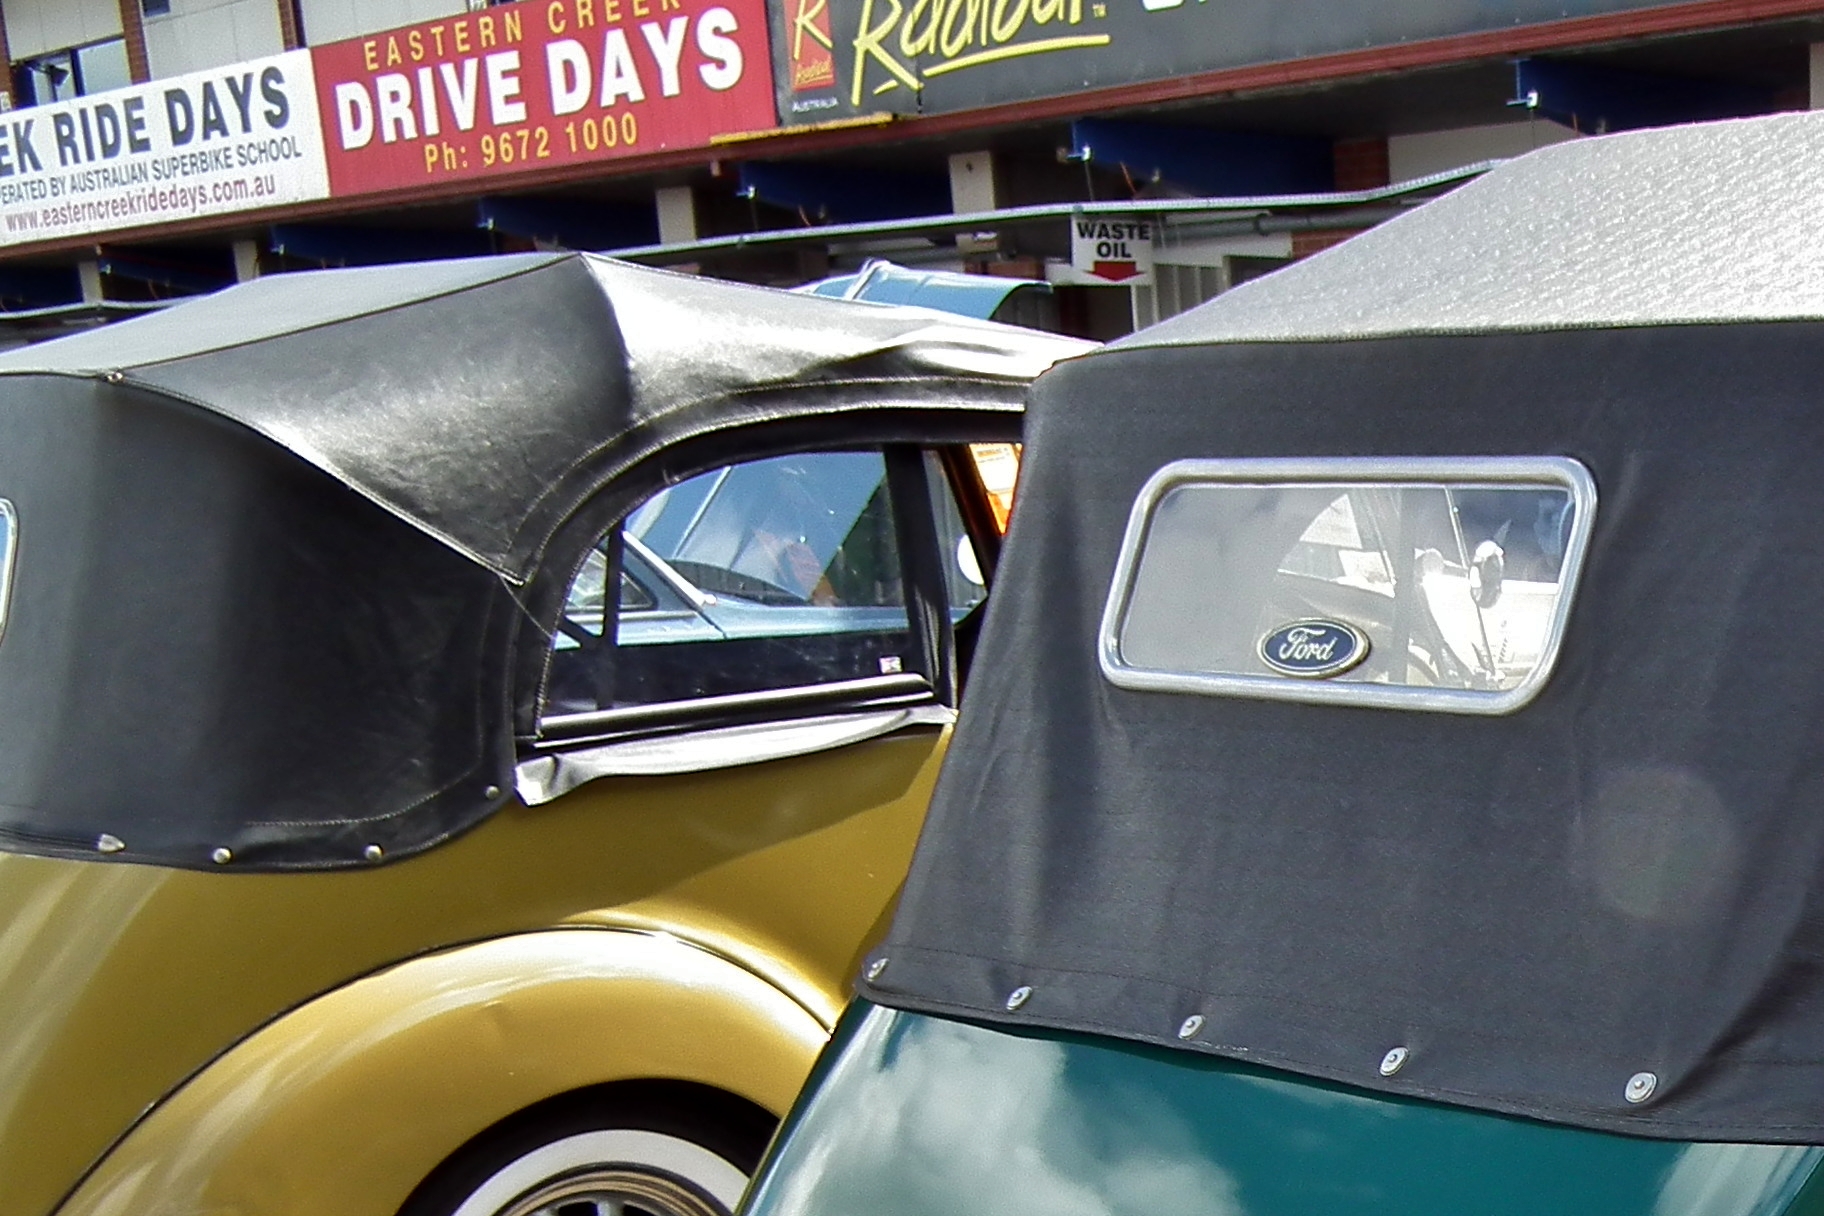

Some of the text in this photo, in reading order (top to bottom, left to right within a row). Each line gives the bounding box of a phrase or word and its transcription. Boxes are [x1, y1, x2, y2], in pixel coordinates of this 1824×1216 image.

[363, 9, 523, 72] EASTERN
[335, 7, 744, 151] DRIVE DAYS
[52, 95, 152, 167] RIDE
[164, 66, 290, 147] DAYS
[424, 111, 638, 174] Ph: 9672 1000
[0, 135, 303, 204] ERATED BY AUSTRALIAN SUPERBIKE SCHOOL
[5, 174, 276, 232] www.easterncreekridedays.com.au
[1077, 222, 1150, 240] WASTE
[1097, 242, 1132, 258] OIL
[1279, 627, 1338, 660] Ford
